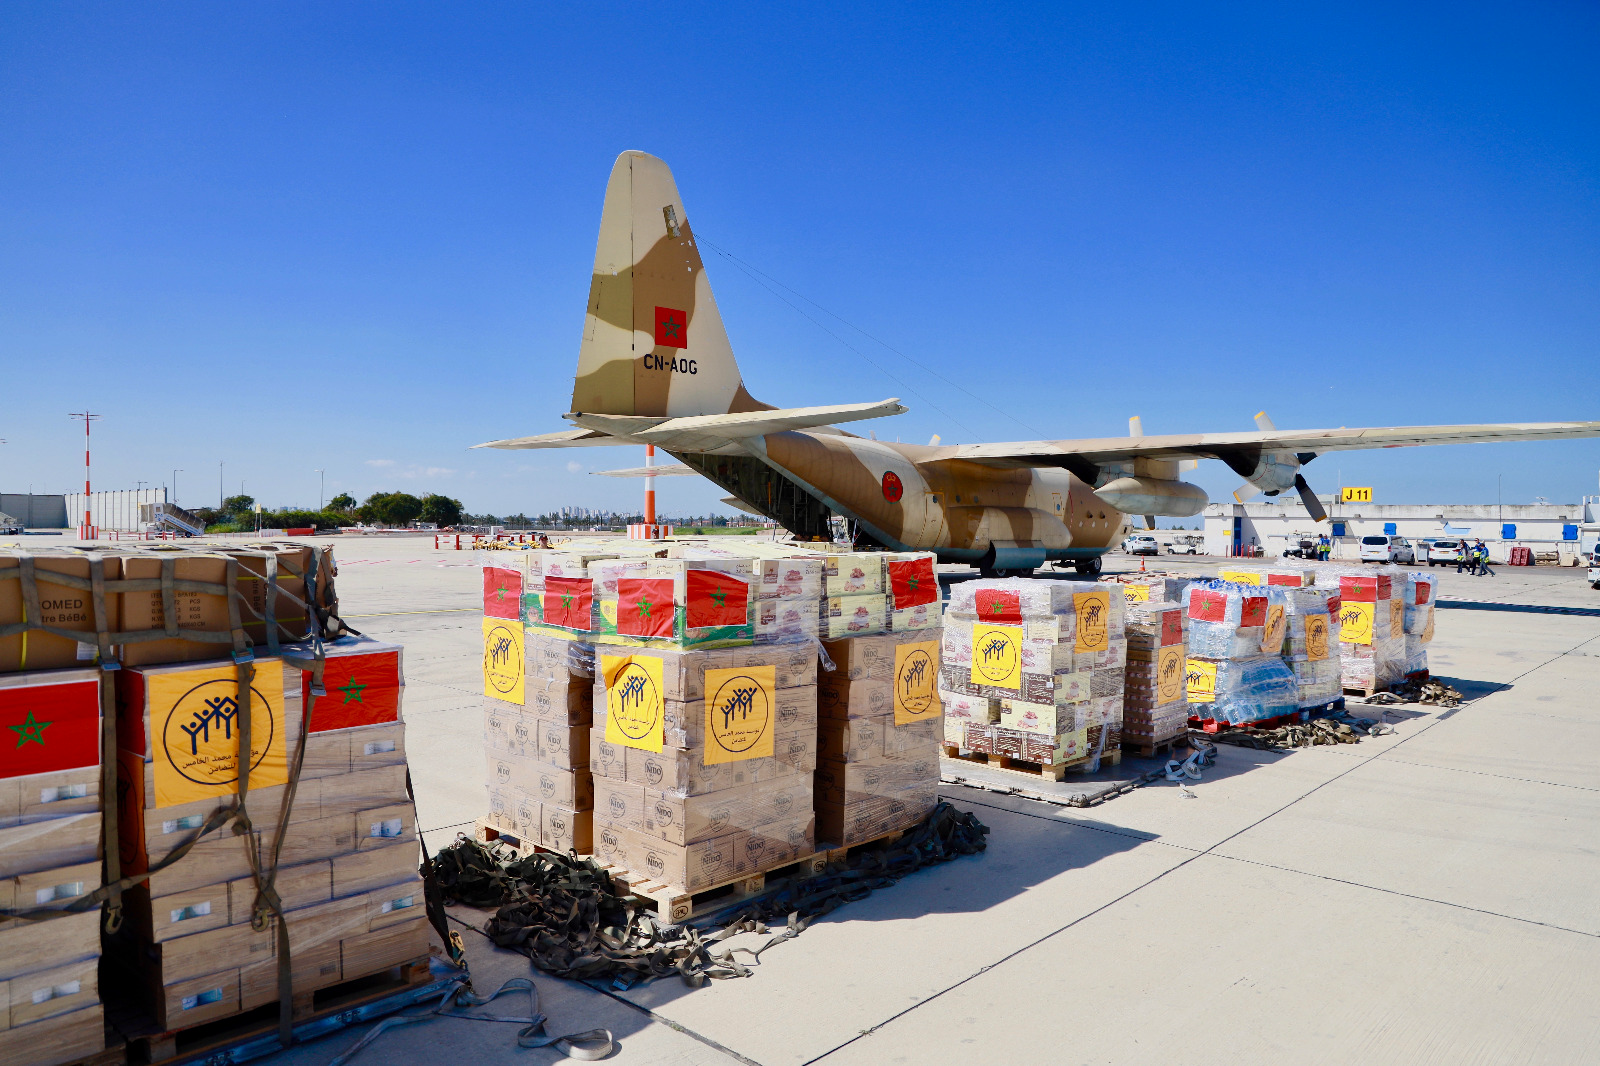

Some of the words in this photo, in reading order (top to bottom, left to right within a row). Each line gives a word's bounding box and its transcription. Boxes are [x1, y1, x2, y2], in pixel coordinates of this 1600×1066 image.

[644, 354, 698, 374] CN-AOG
[1346, 490, 1352, 500] J
[1356, 490, 1368, 500] 11
[42, 600, 82, 610] OMED
